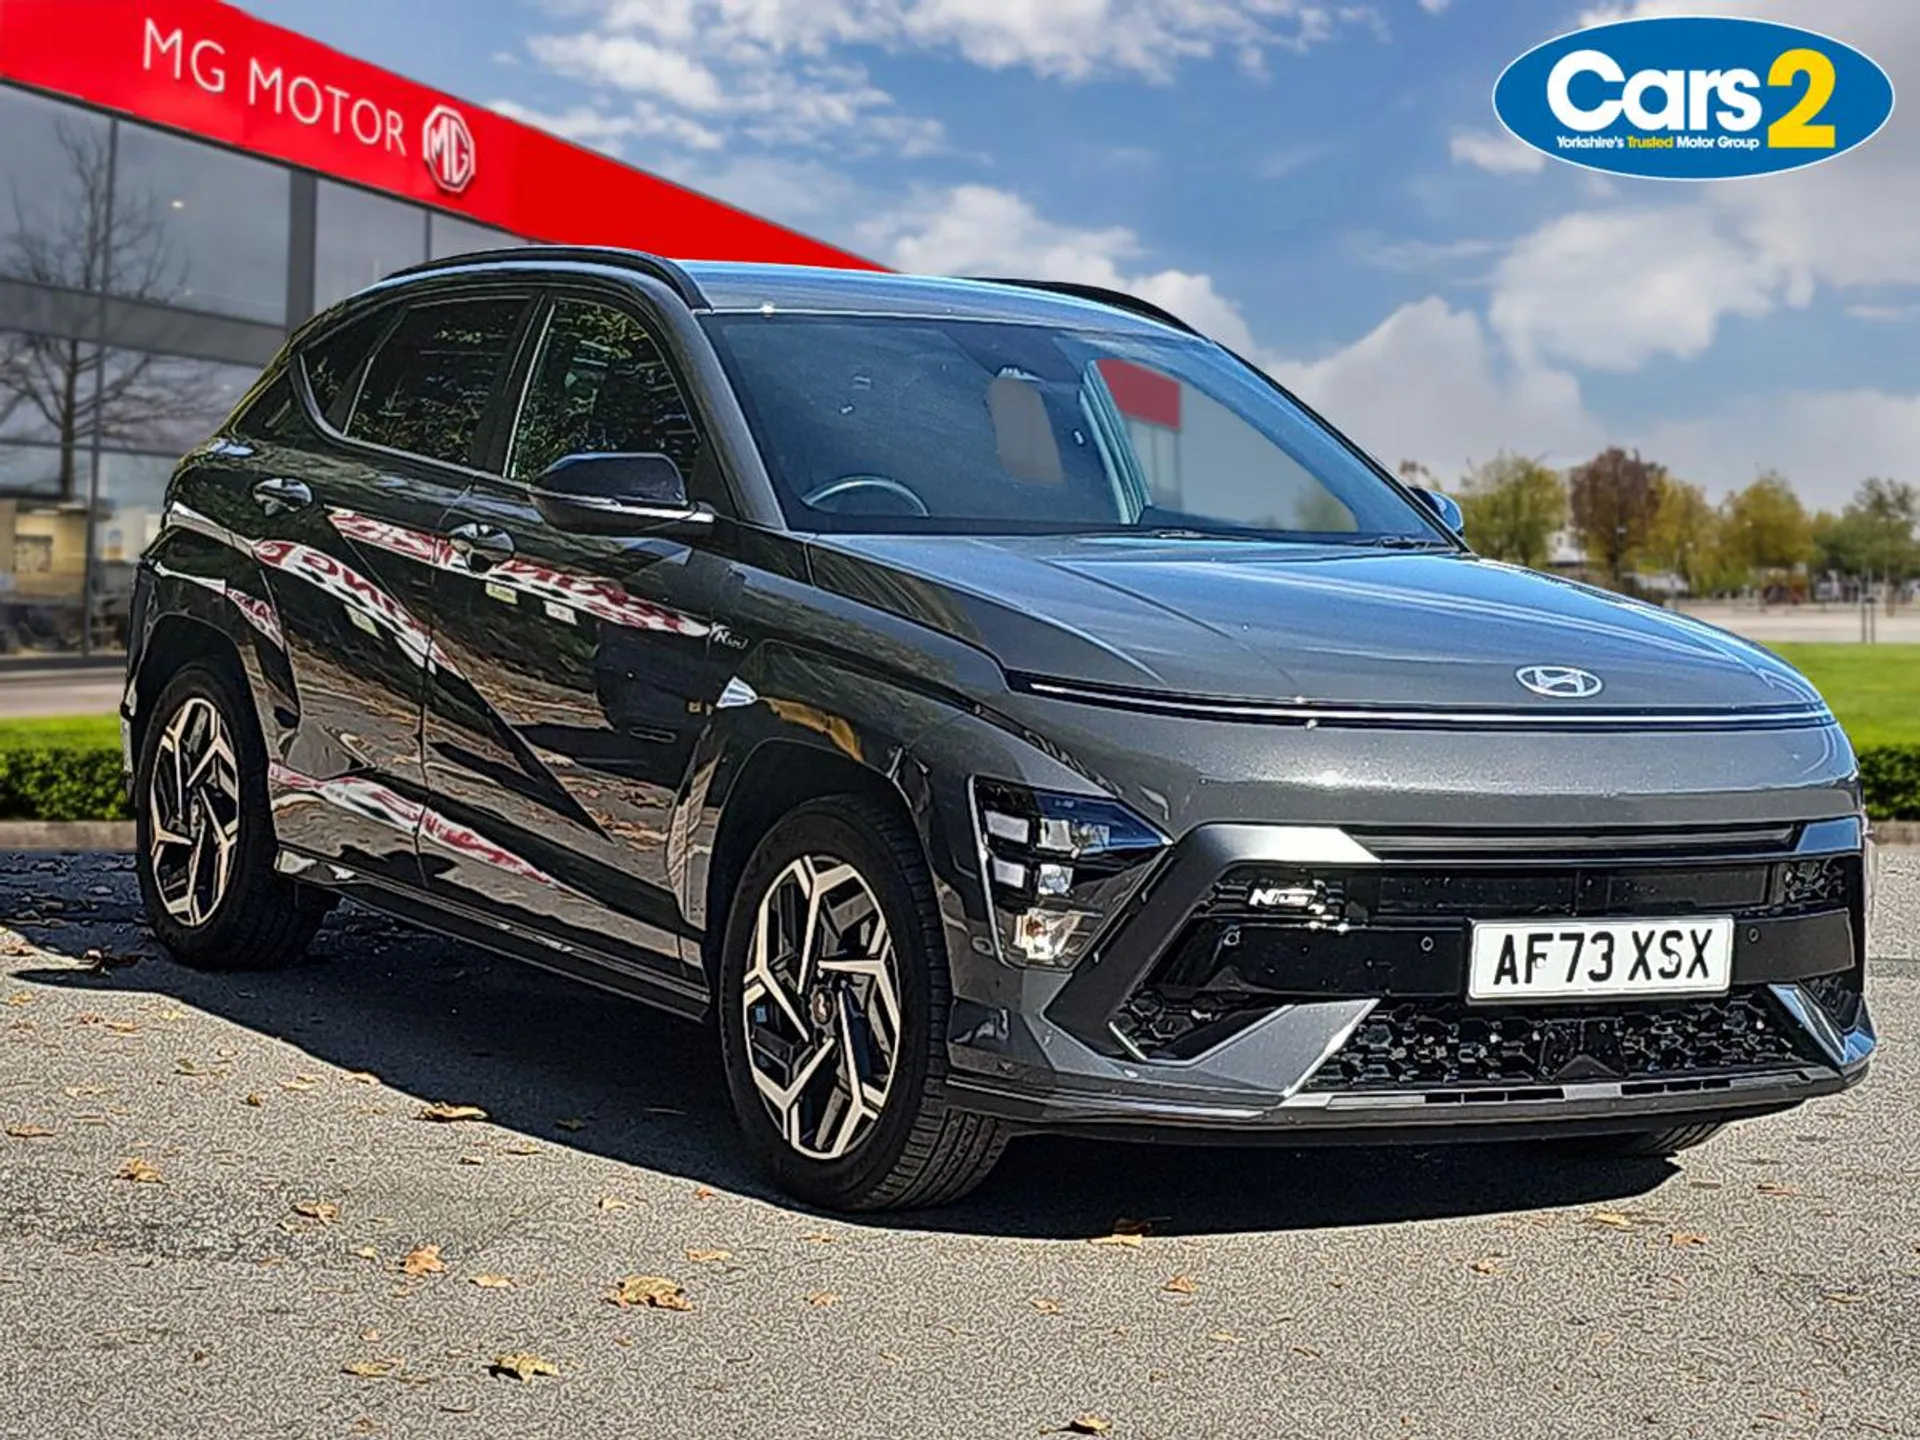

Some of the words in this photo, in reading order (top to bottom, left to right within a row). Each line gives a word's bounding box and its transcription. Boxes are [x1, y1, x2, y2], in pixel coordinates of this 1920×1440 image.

[143, 17, 226, 93] MG
[249, 57, 407, 157] MOTOR
[430, 113, 473, 186] MG
[1493, 931, 1615, 985] AF73
[1627, 929, 1713, 982] XSX
